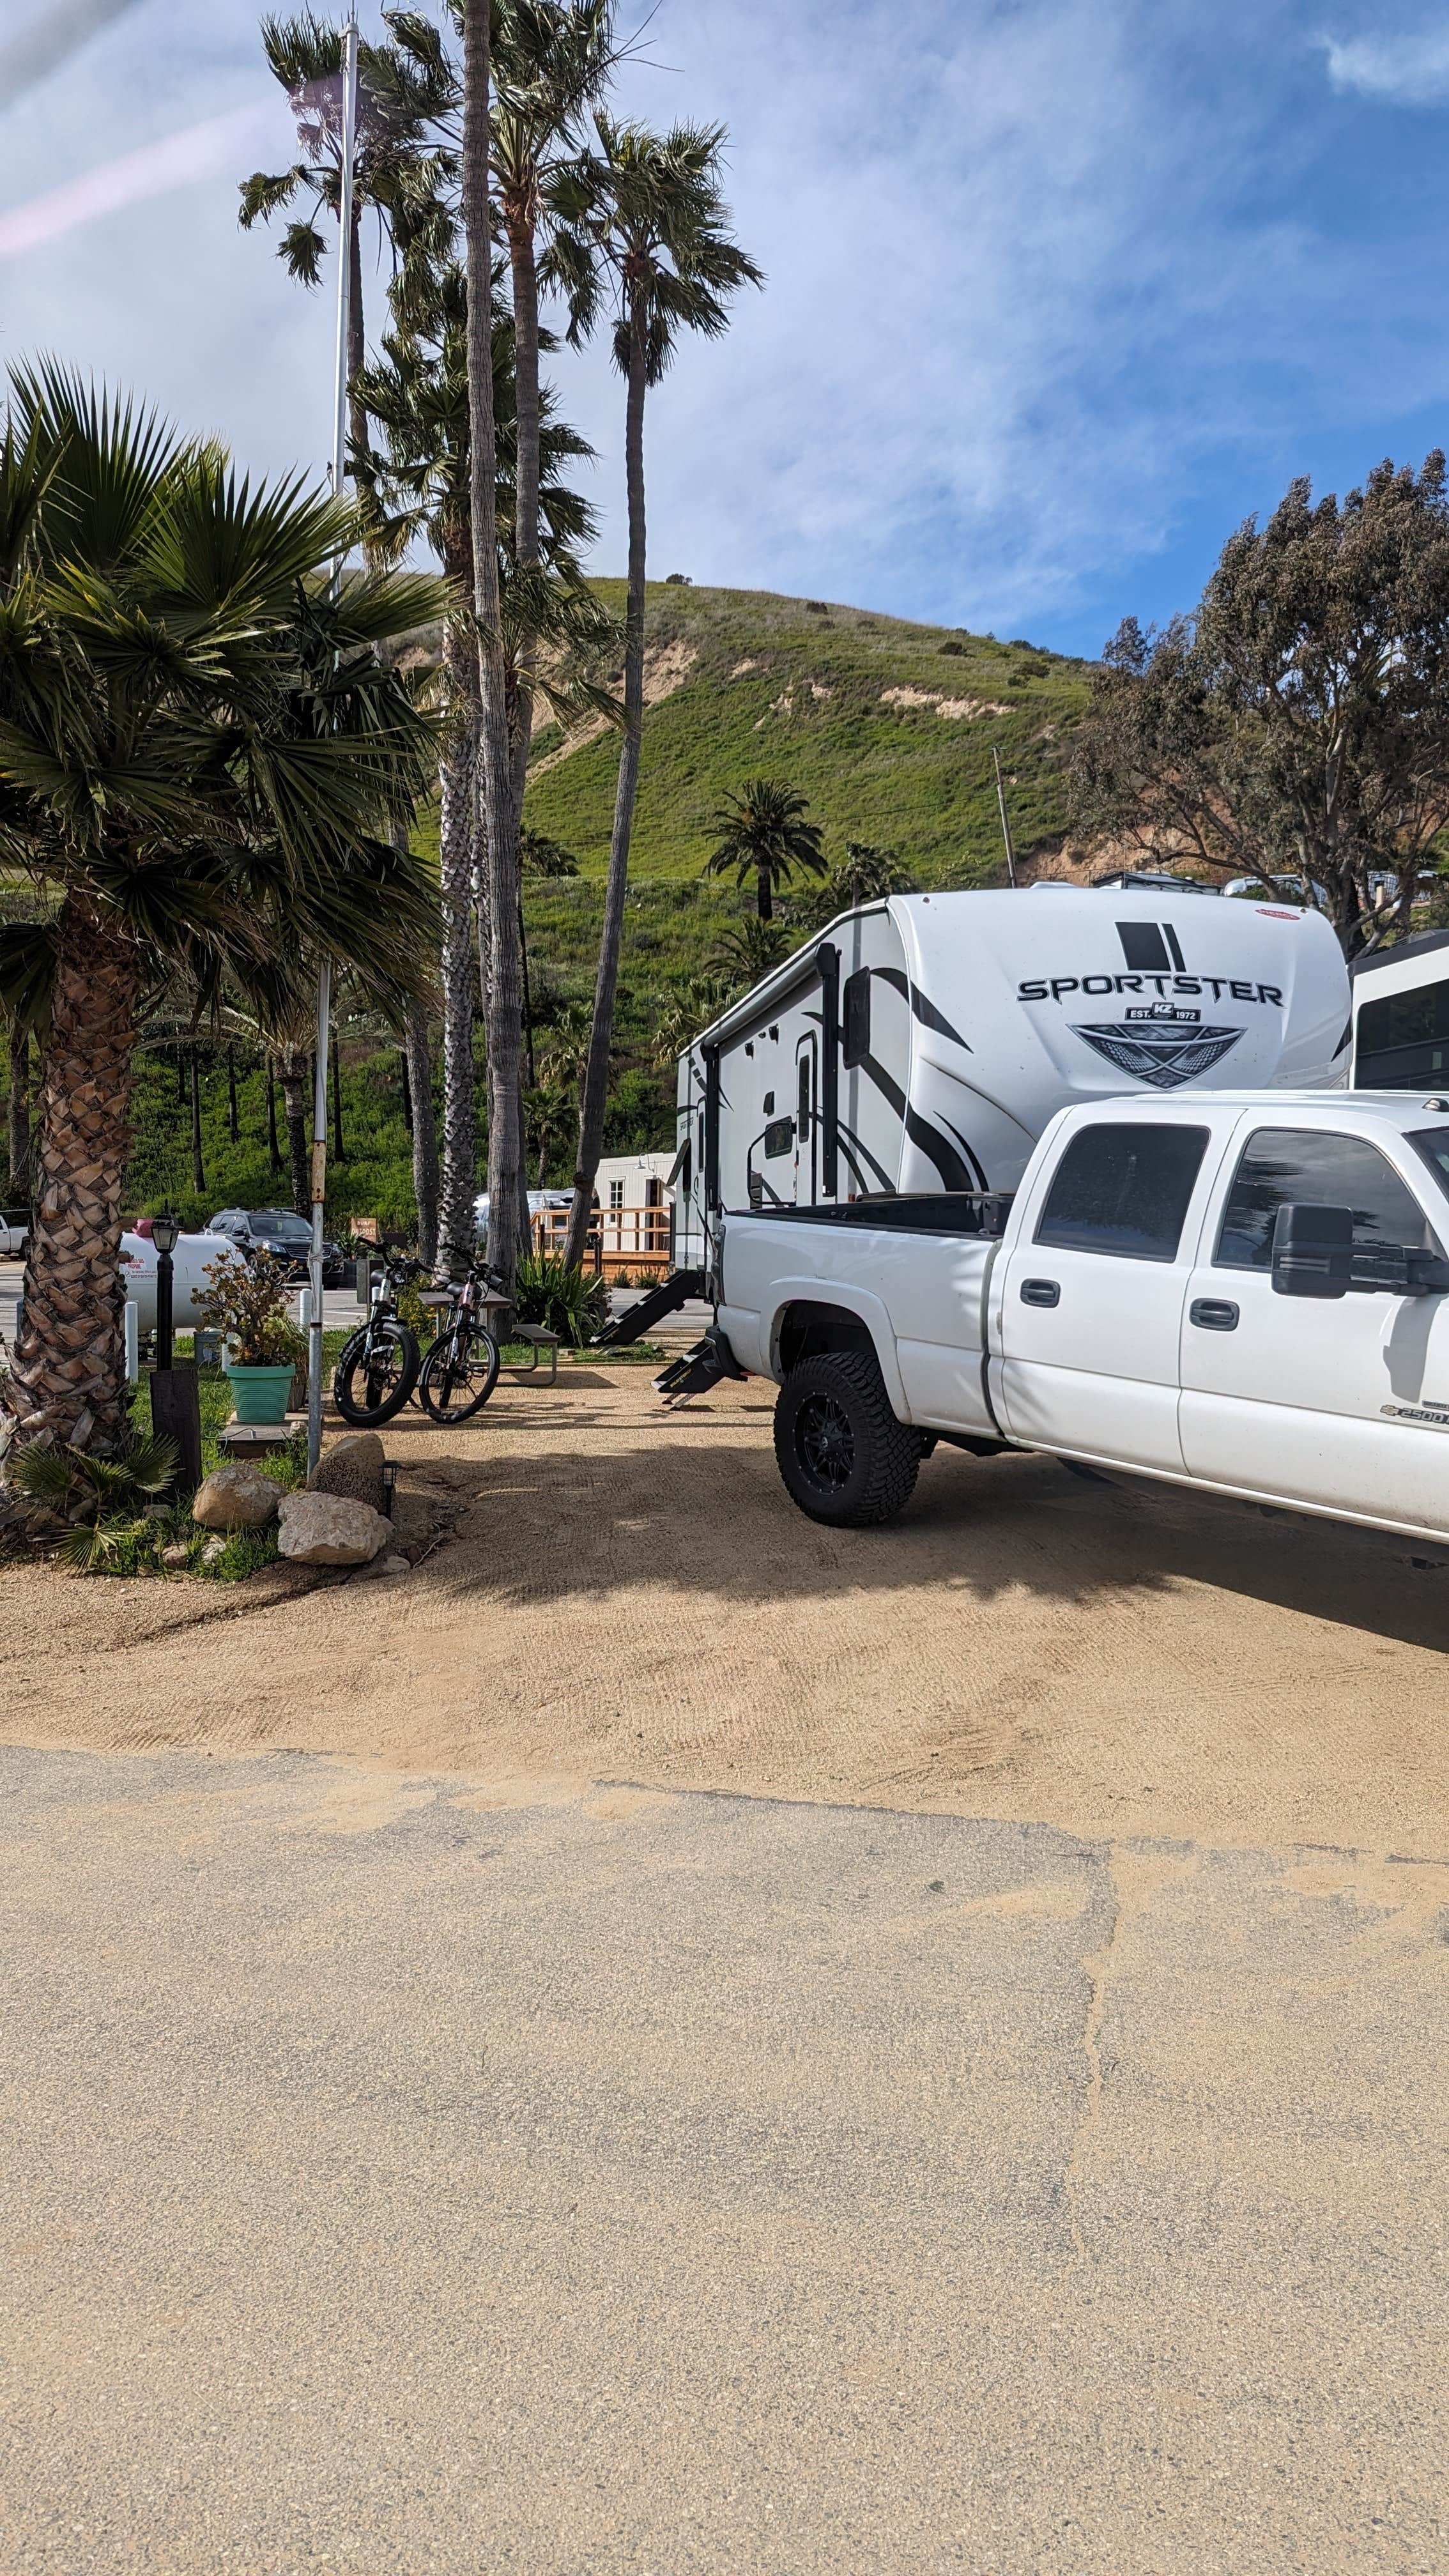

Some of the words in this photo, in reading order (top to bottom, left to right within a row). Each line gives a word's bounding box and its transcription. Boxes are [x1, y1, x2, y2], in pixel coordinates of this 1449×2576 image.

[1017, 974, 1286, 1008] SPORTSTER
[1154, 1004, 1172, 1013] KZ
[1130, 1010, 1151, 1018] EST.
[1176, 1011, 1195, 1020] 1972
